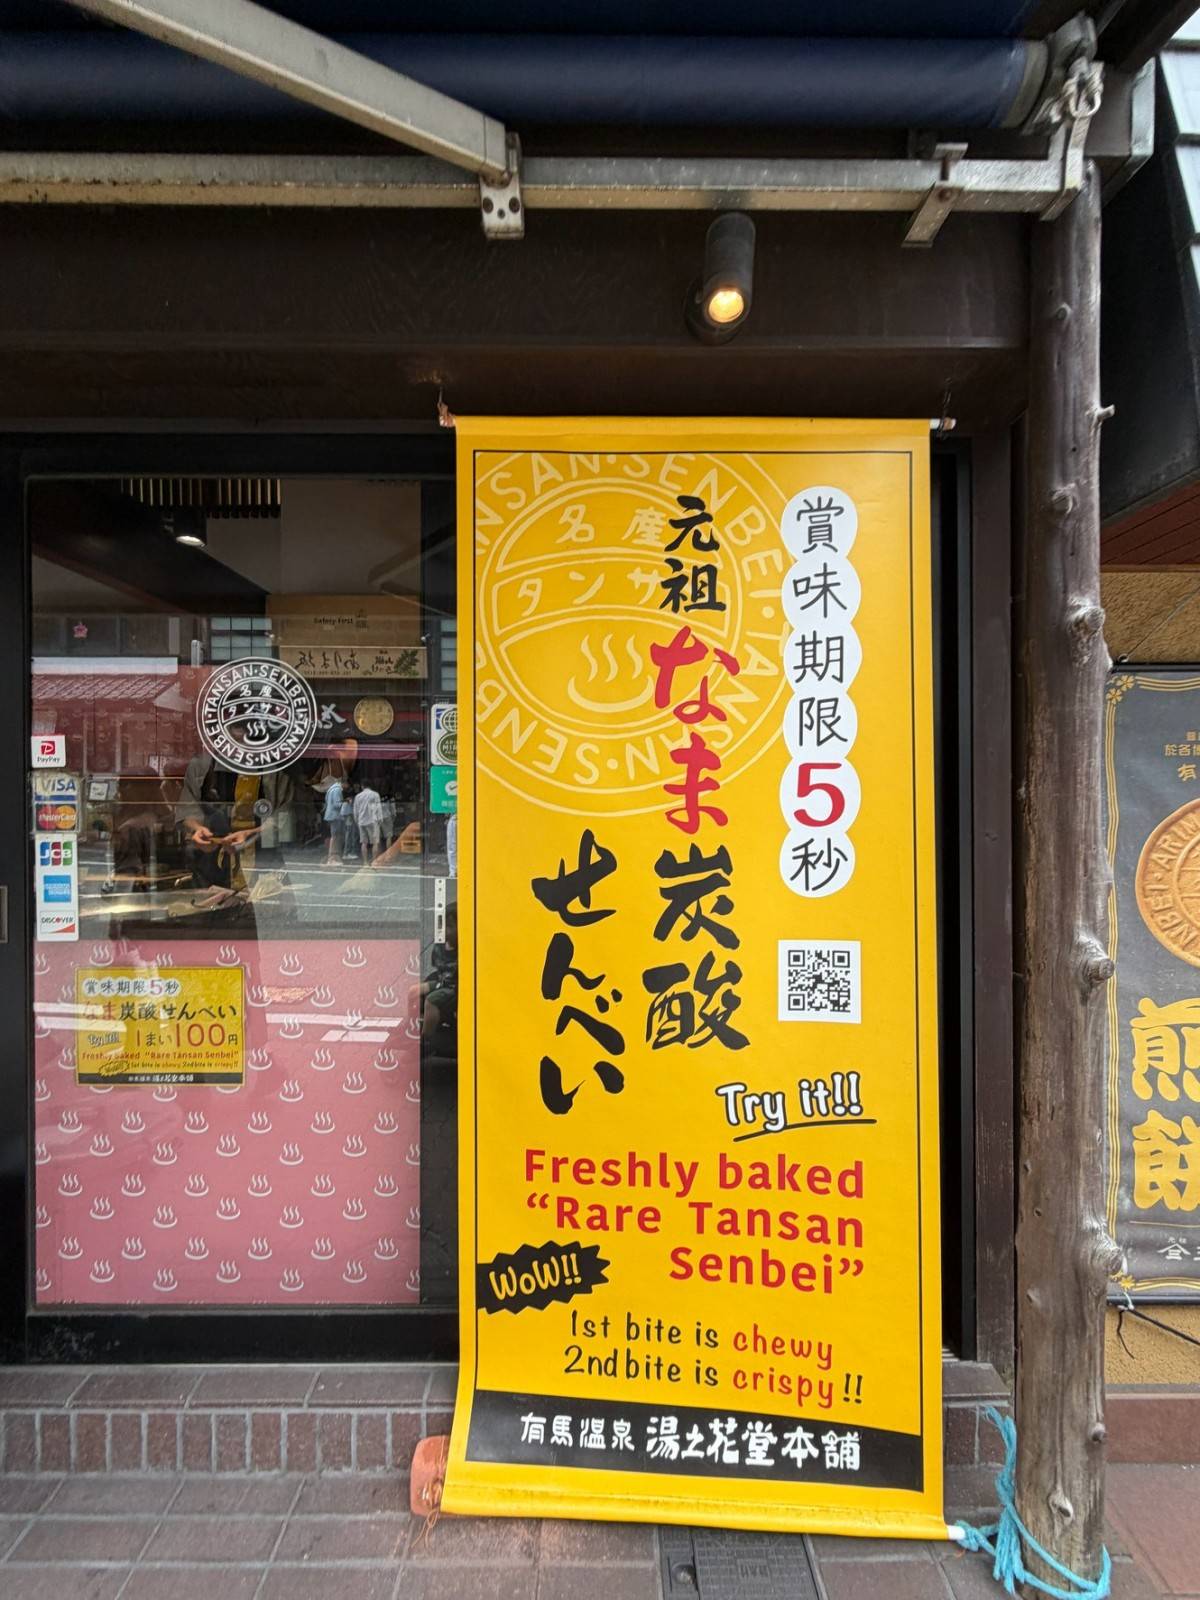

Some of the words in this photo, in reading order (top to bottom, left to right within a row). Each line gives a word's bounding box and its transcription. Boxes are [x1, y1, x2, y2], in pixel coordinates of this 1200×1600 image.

[791, 497, 848, 891] 賞味期限5秒
[37, 756, 60, 764] PayPay
[41, 778, 76, 791] VISA
[40, 845, 72, 862] JCB
[532, 829, 625, 1115] せんべい
[715, 1083, 785, 1131] Try
[799, 1071, 864, 1117] it!!
[525, 1149, 699, 1198] Freshly
[719, 1153, 863, 1199] baked
[689, 1201, 863, 1249] Tansan
[571, 1310, 611, 1338] 1st
[626, 1312, 681, 1344] bite
[695, 1322, 719, 1348] is
[733, 1323, 833, 1371] chewy
[695, 1360, 719, 1387] is
[520, 1411, 635, 1451] 有馬温泉
